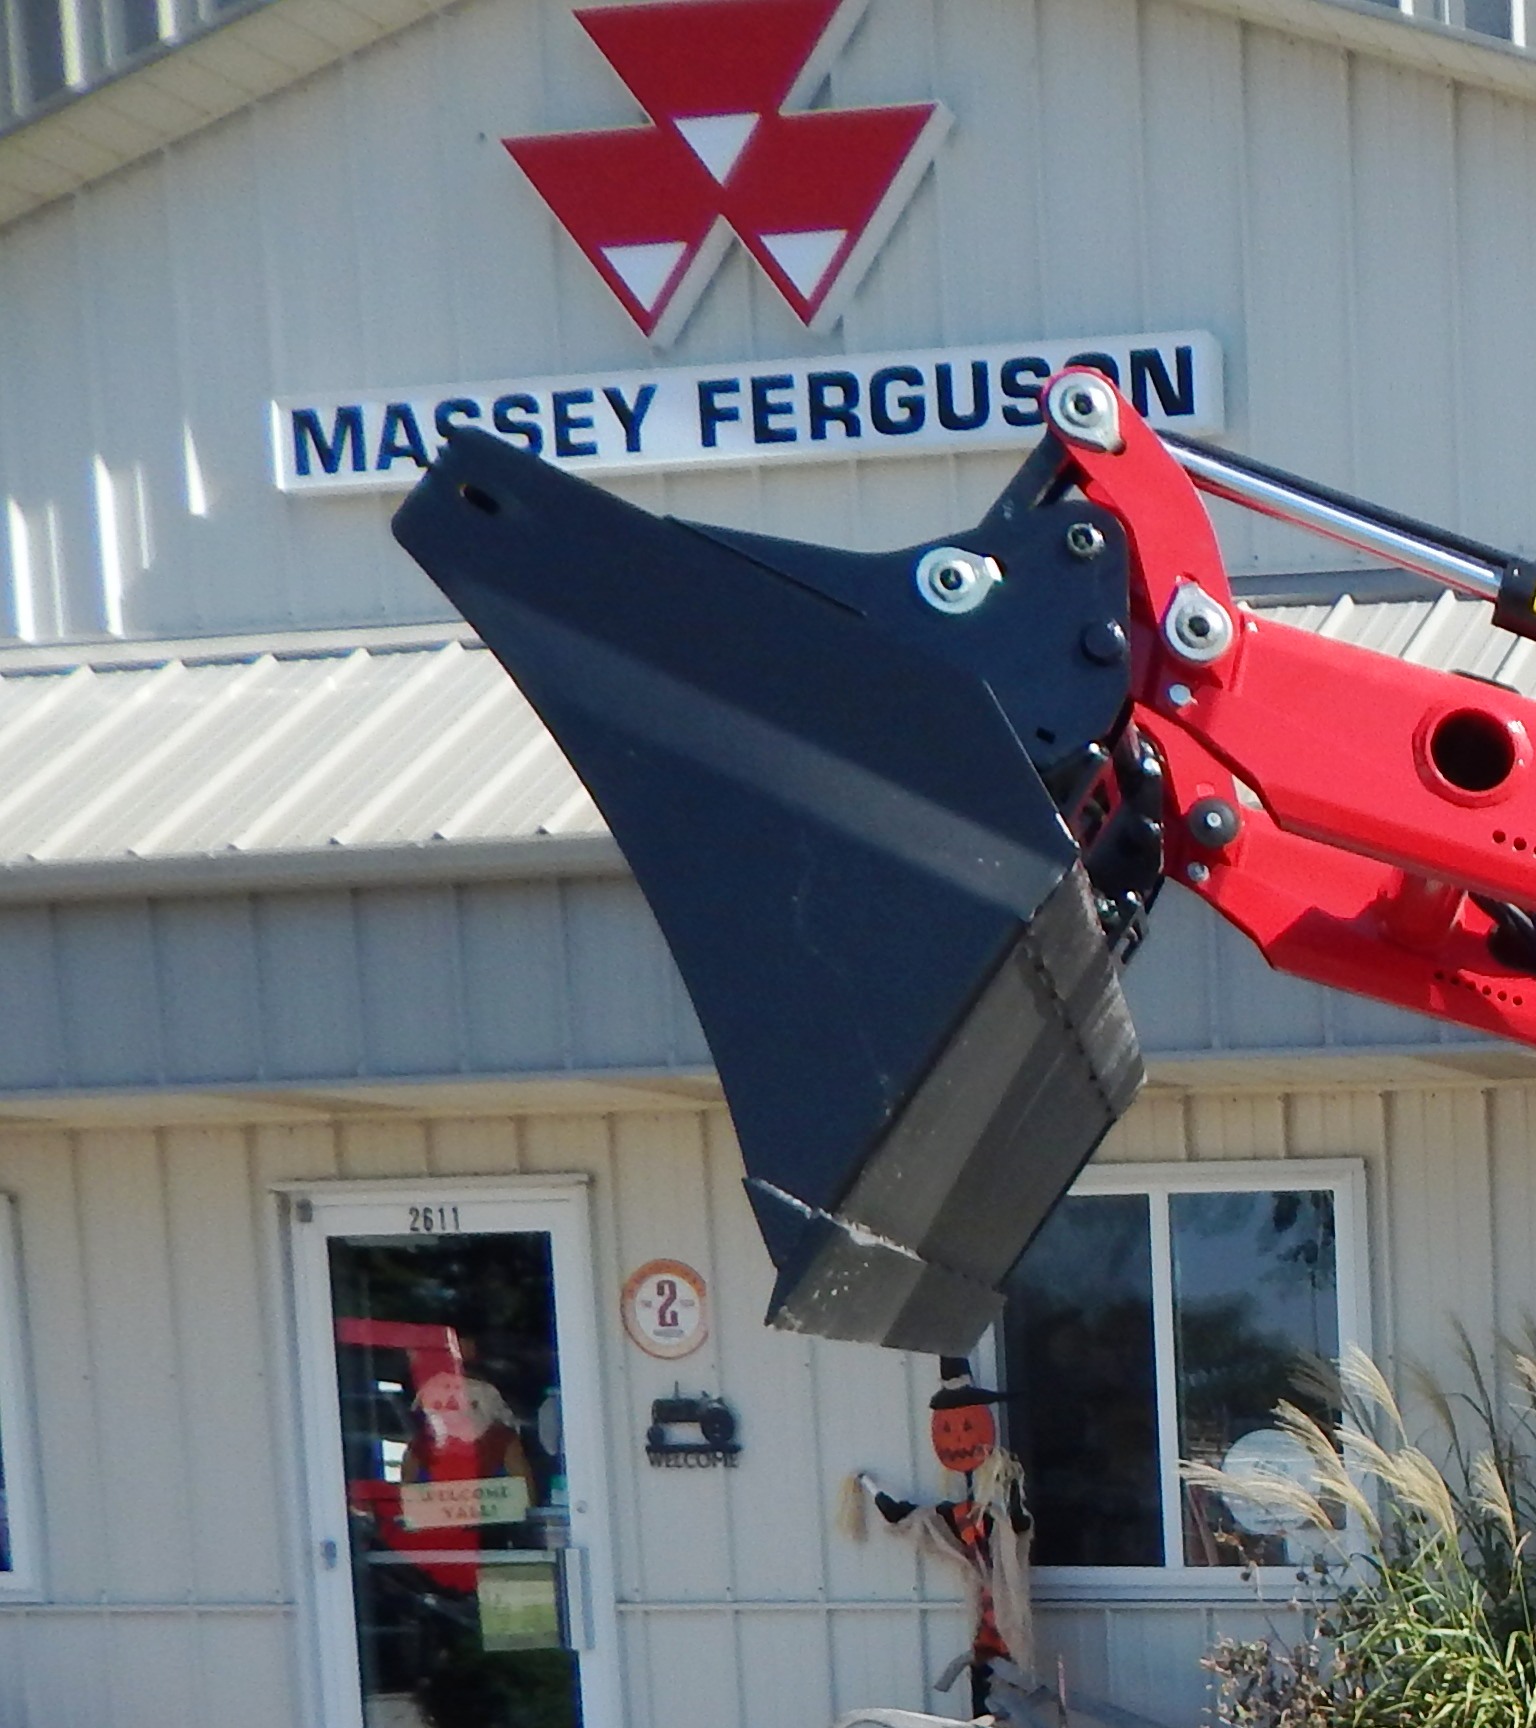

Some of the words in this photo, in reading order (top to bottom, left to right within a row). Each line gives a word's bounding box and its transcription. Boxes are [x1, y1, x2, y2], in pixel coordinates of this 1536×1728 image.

[697, 344, 1196, 448] FERGUSN
[408, 1206, 460, 1231] 2611
[647, 1450, 740, 1469] WELCOME
